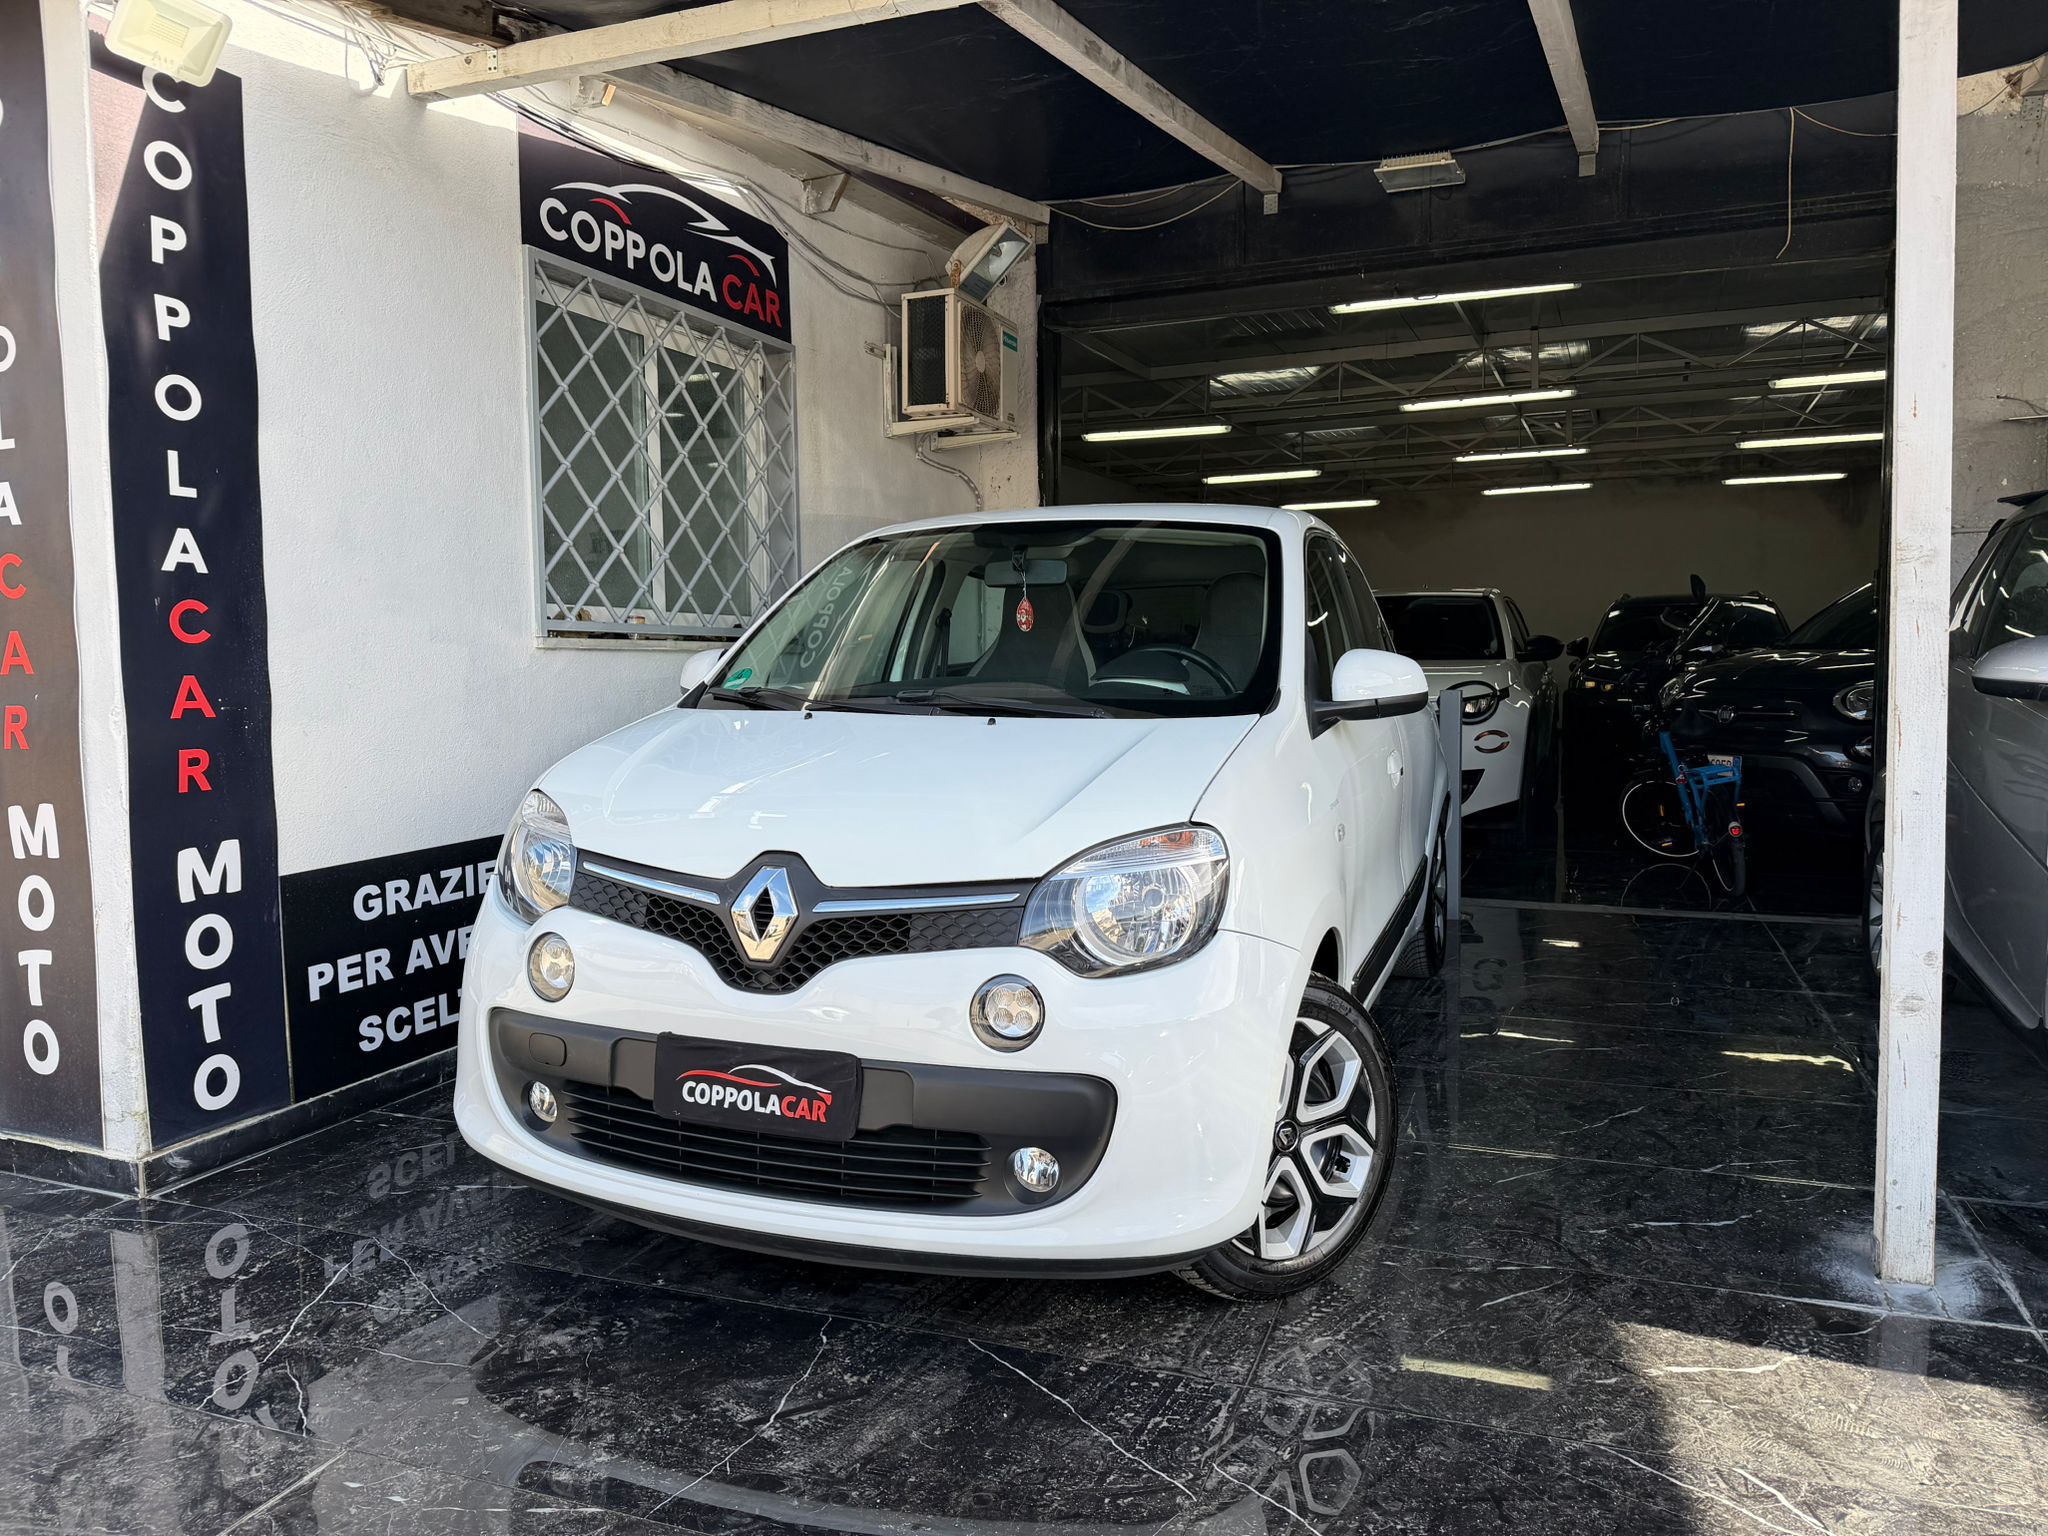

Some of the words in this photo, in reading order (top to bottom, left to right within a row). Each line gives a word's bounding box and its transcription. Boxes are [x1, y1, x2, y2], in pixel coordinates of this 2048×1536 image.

[353, 859, 497, 922] GRAZIE
[8, 803, 60, 1075] MOTO
[177, 839, 242, 1111] MOTO
[308, 947, 394, 1002] PER
[358, 988, 462, 1052] SCEL
